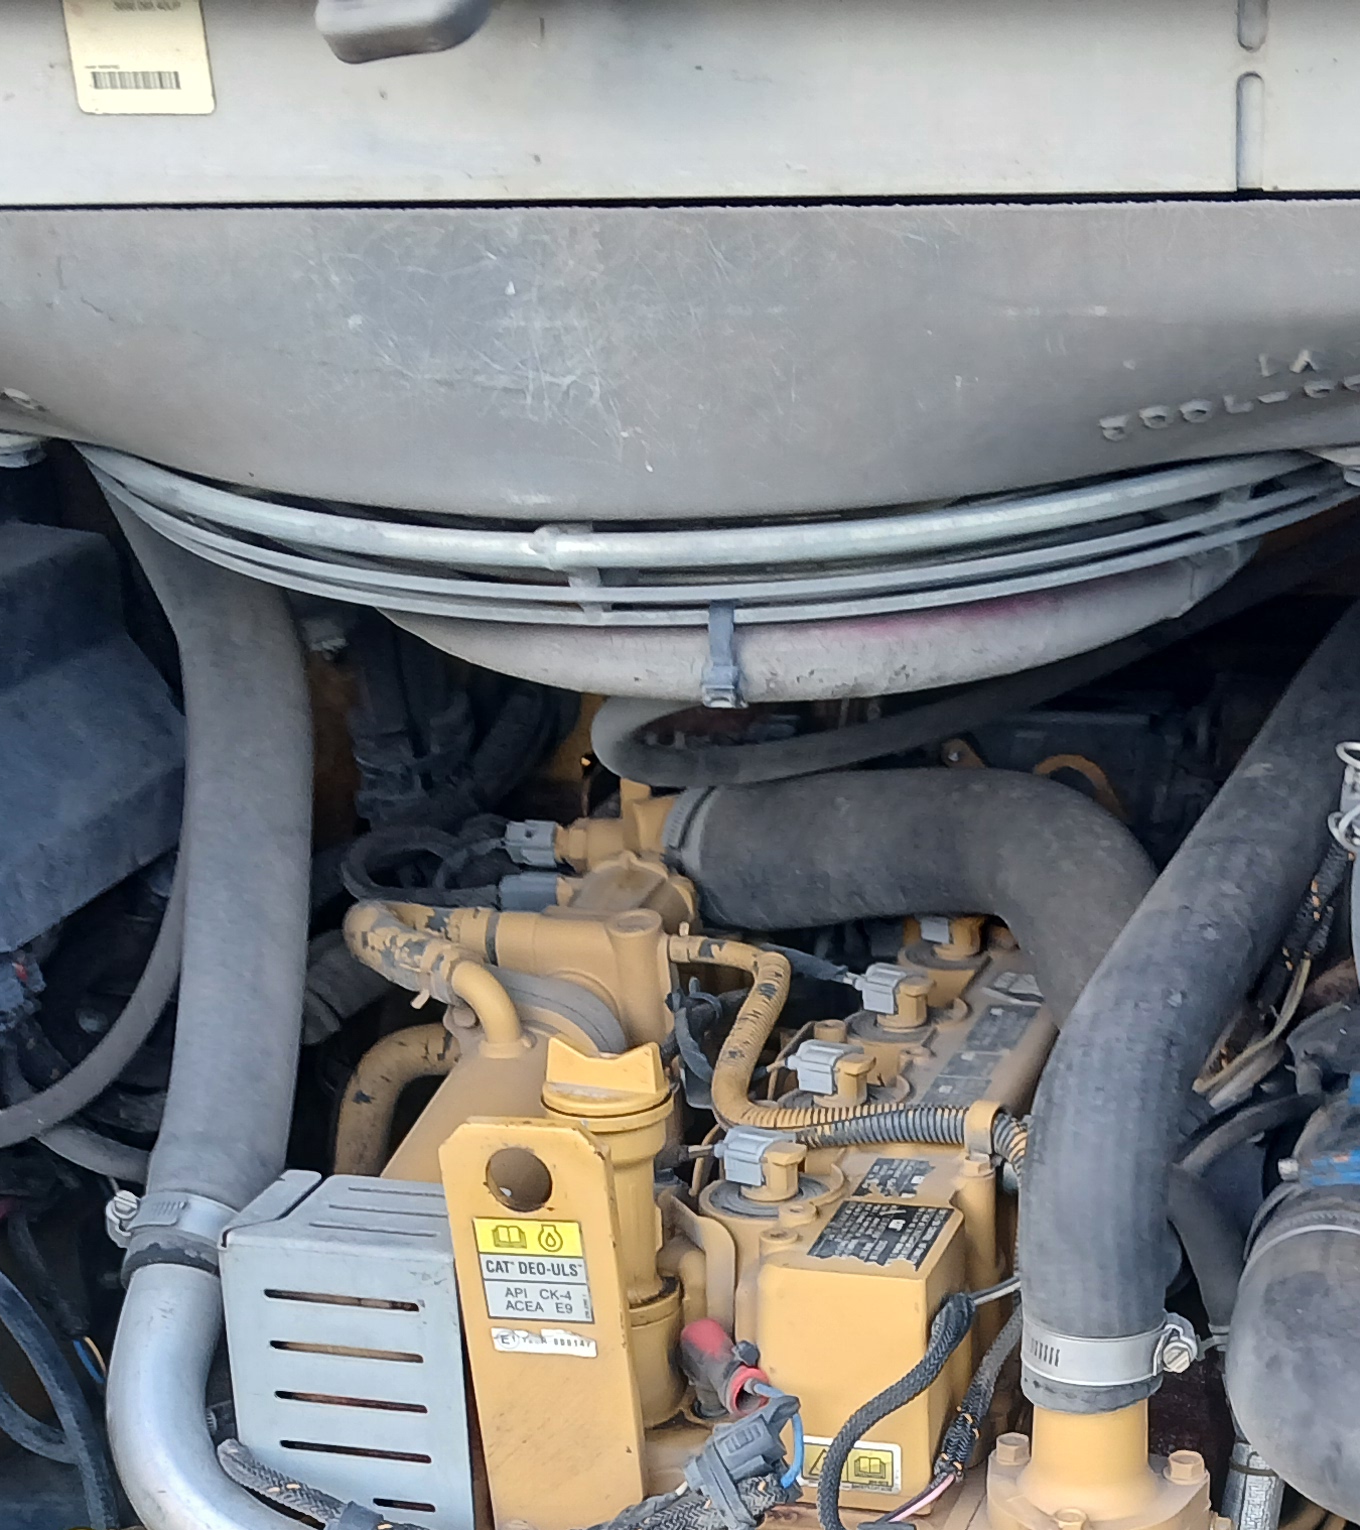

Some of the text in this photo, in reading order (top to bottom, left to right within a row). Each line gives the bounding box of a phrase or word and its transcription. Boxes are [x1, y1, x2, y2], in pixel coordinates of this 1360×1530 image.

[518, 1261, 579, 1277] DEO-ULS
[505, 1287, 572, 1301] API CK-4
[505, 1300, 544, 1313] ACEA
[555, 1302, 573, 1314] E9
